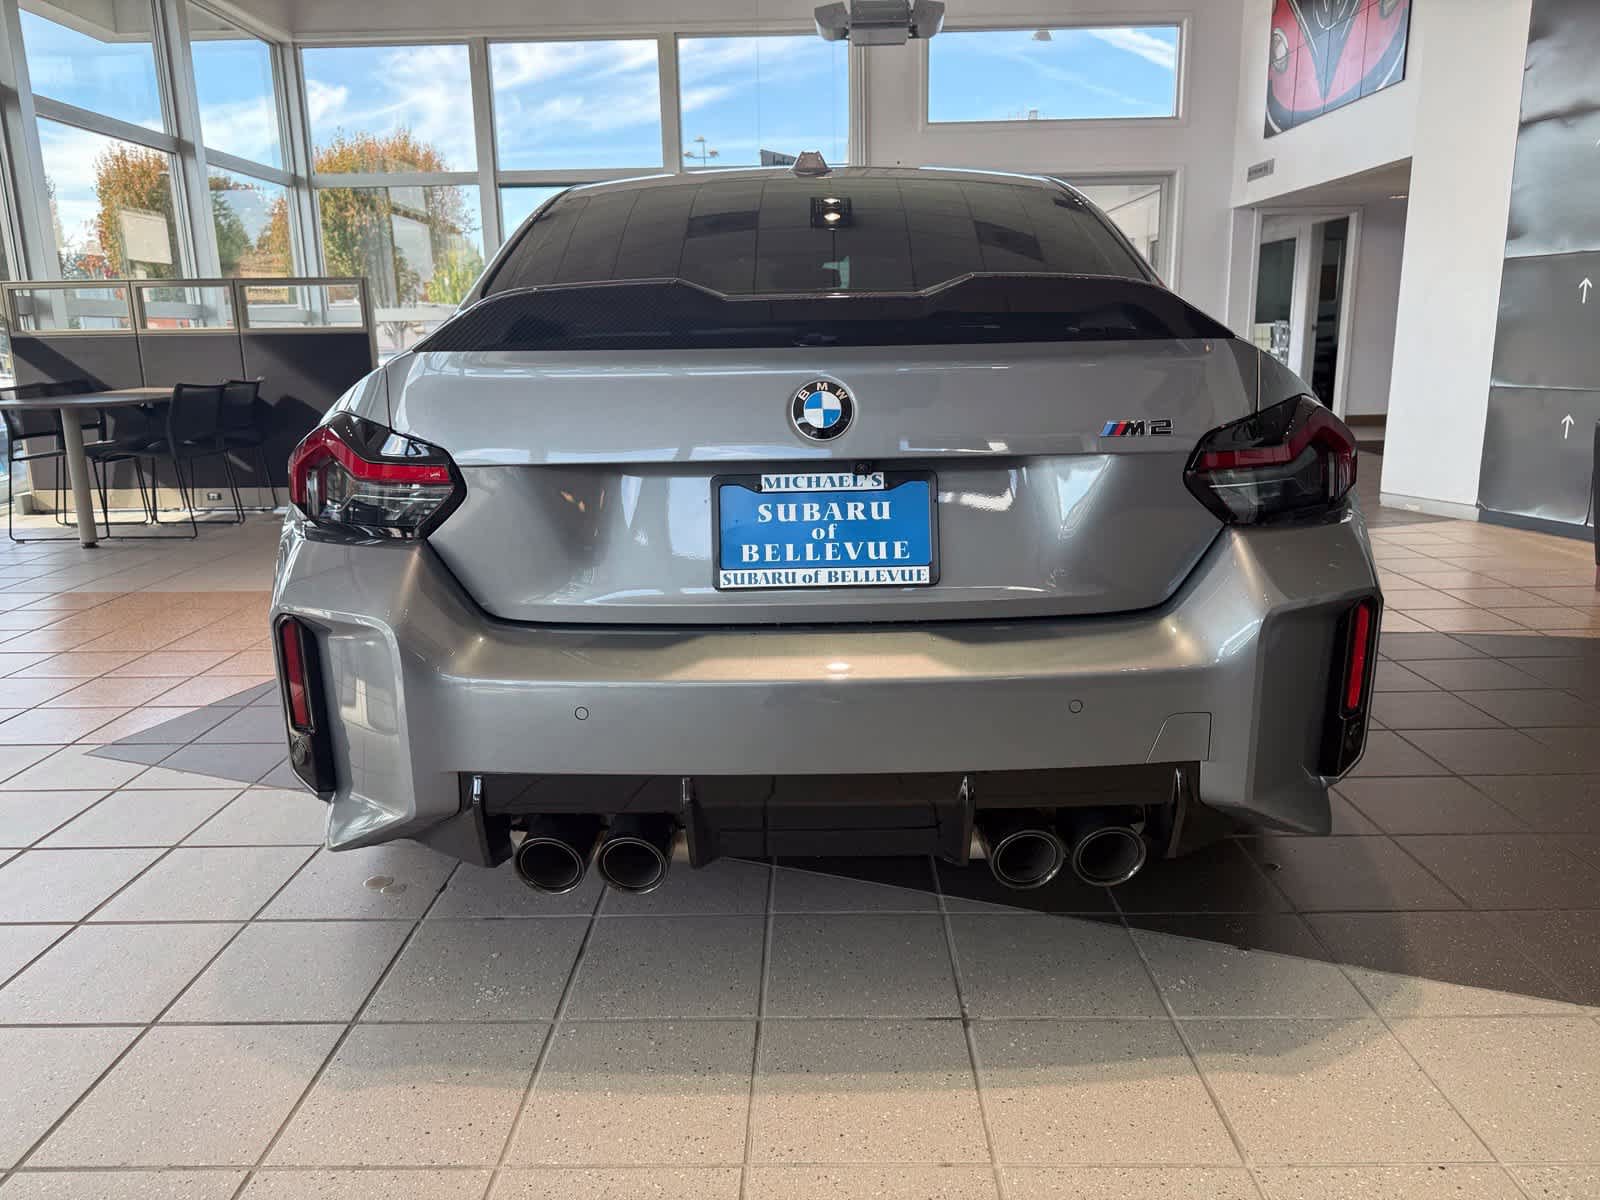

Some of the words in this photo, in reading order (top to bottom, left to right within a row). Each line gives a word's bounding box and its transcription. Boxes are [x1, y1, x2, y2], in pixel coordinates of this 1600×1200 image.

[798, 382, 848, 401] BMW
[1121, 419, 1173, 436] M2
[763, 474, 882, 489] MICHAEL'S
[757, 501, 891, 522] SUBARU
[811, 524, 837, 540] of
[741, 541, 910, 562] BELLEVUE
[722, 571, 797, 586] SUBARU
[802, 570, 823, 584] of
[828, 568, 928, 583] BELLEVUE
